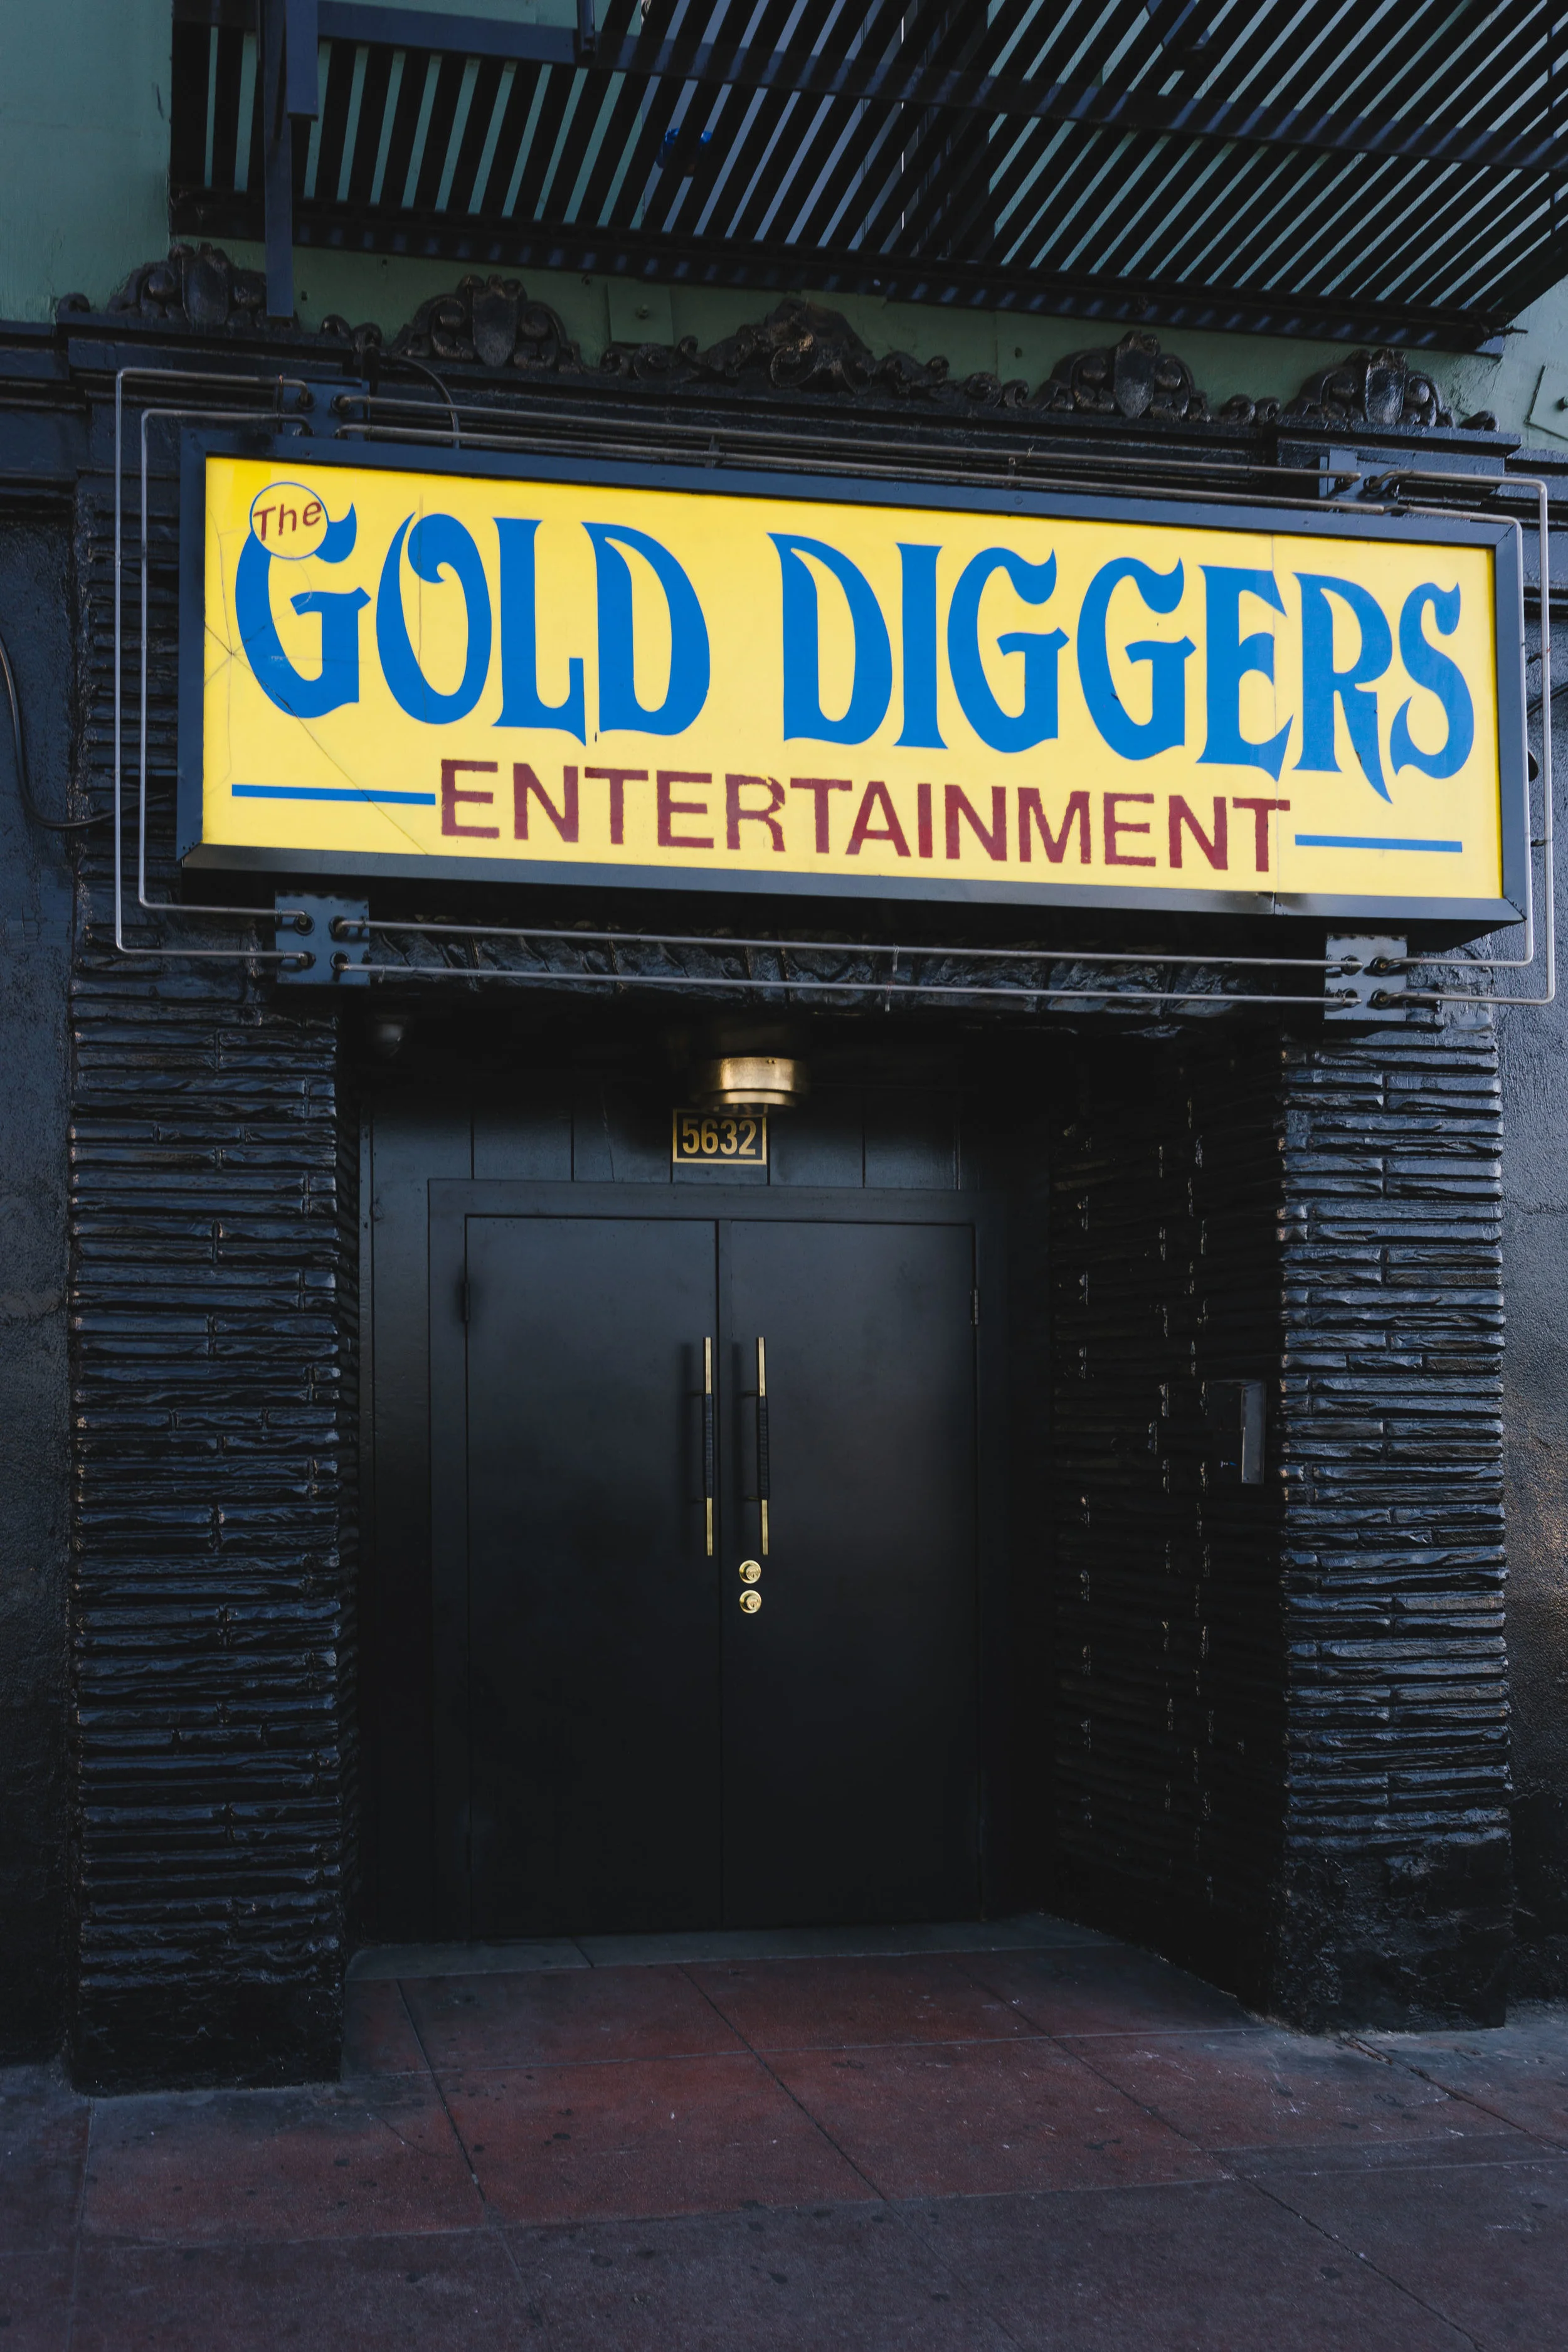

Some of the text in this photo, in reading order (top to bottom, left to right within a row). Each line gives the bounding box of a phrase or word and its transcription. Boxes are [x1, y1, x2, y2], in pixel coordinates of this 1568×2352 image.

[253, 501, 322, 541] The
[235, 502, 1474, 803] GOLD DIGGERS
[440, 759, 1291, 873] ENTERTAINMENT
[682, 1118, 756, 1155] 5632
